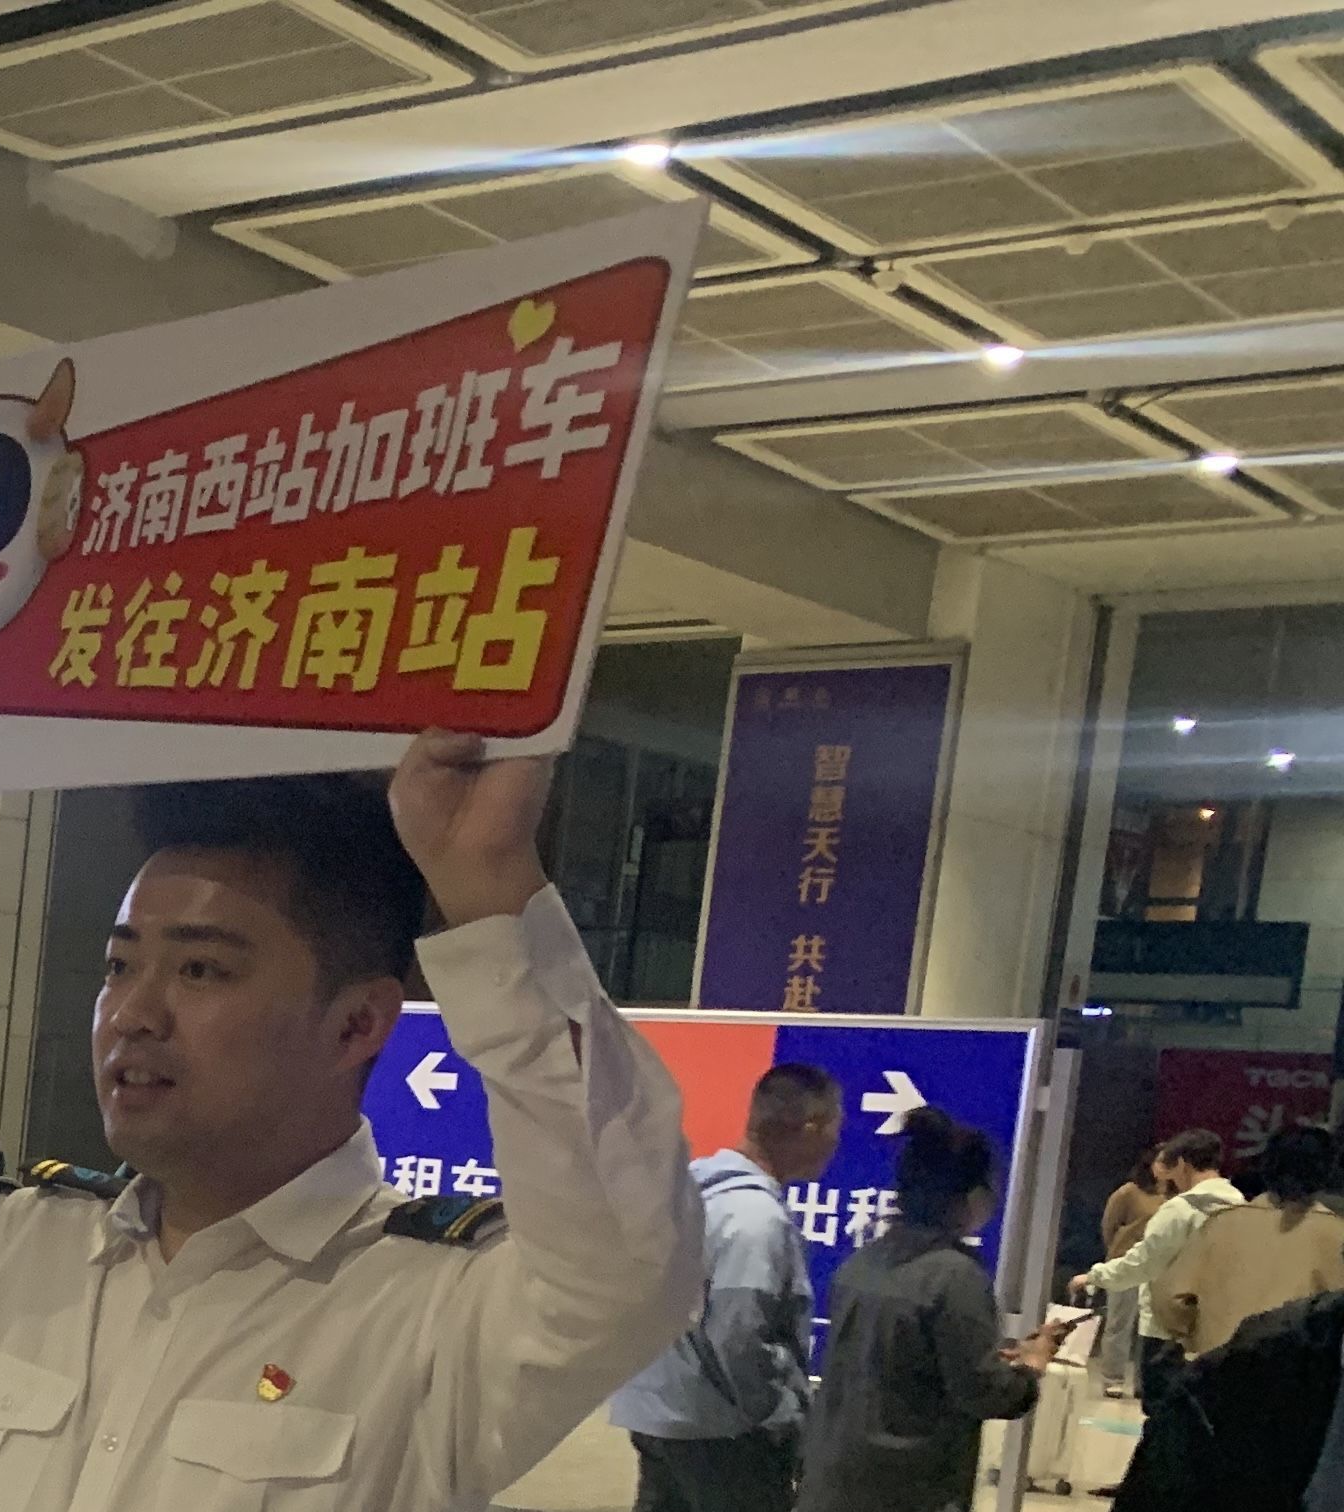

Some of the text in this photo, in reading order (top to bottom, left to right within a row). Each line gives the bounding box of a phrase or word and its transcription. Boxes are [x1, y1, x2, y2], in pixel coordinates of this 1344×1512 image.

[82, 335, 622, 556] 济南西站加班车
[49, 526, 560, 693] 发往济南站
[798, 744, 852, 904] 智慧天行
[378, 1155, 501, 1198] 租车
